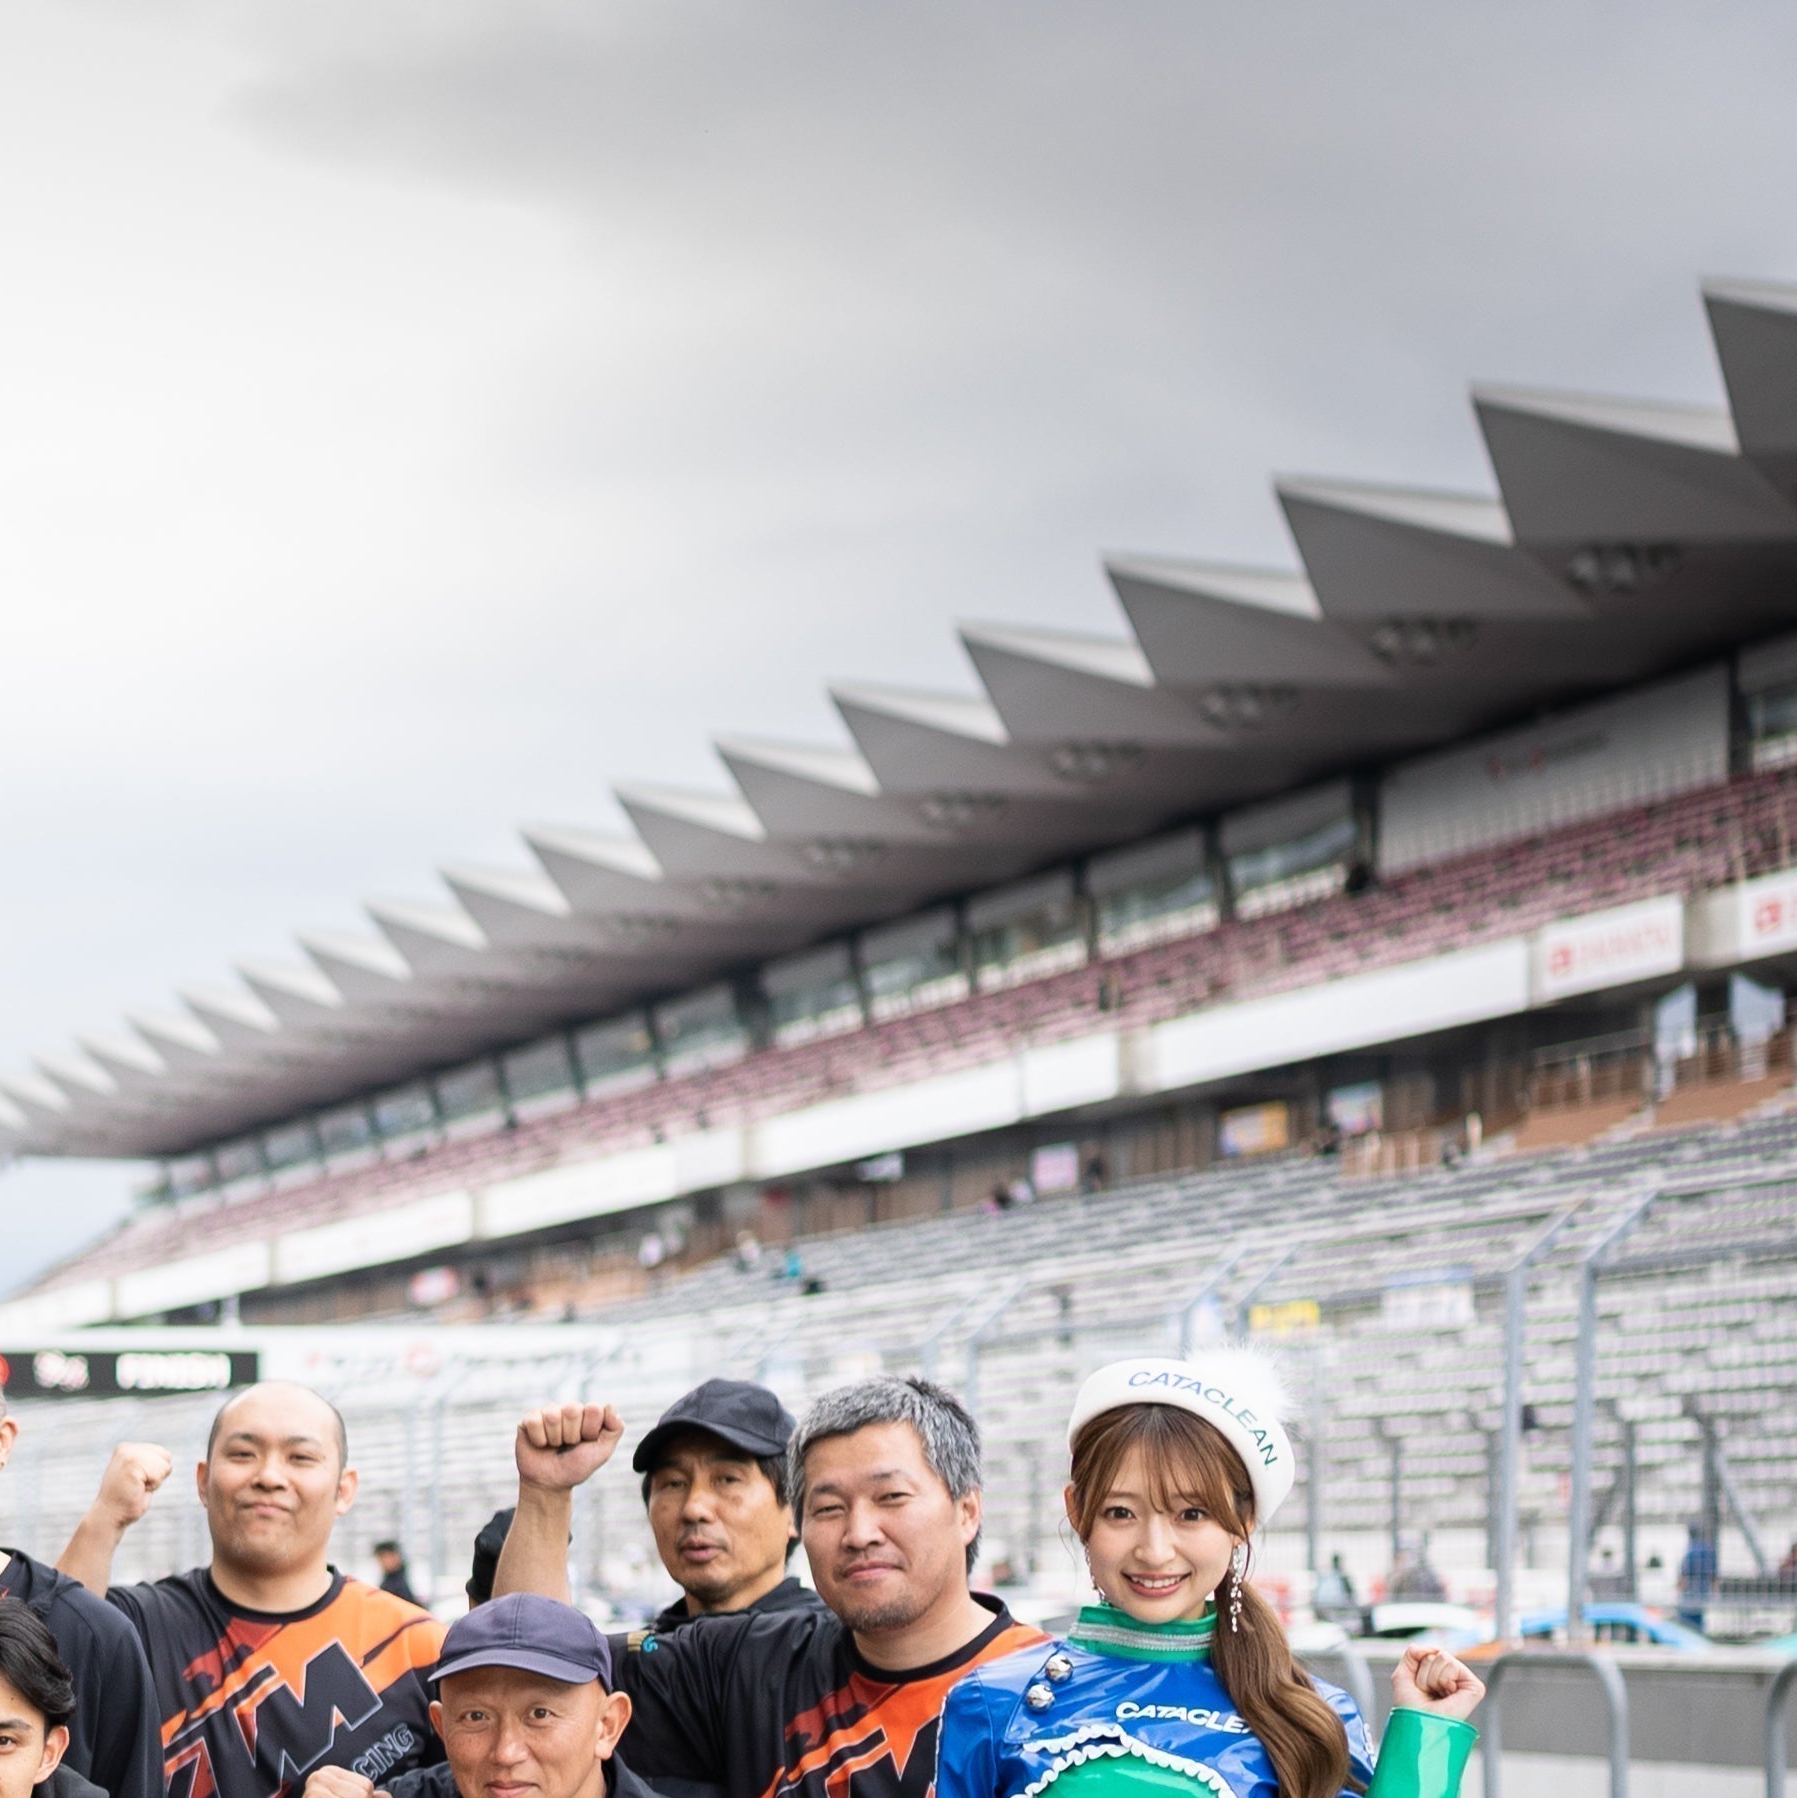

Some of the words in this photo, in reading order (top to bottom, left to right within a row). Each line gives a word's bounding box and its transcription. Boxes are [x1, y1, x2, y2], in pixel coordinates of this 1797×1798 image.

[1128, 1371, 1279, 1468] CATACLEAN
[1115, 1701, 1254, 1734] CATACLE
[351, 1722, 416, 1784] CING
